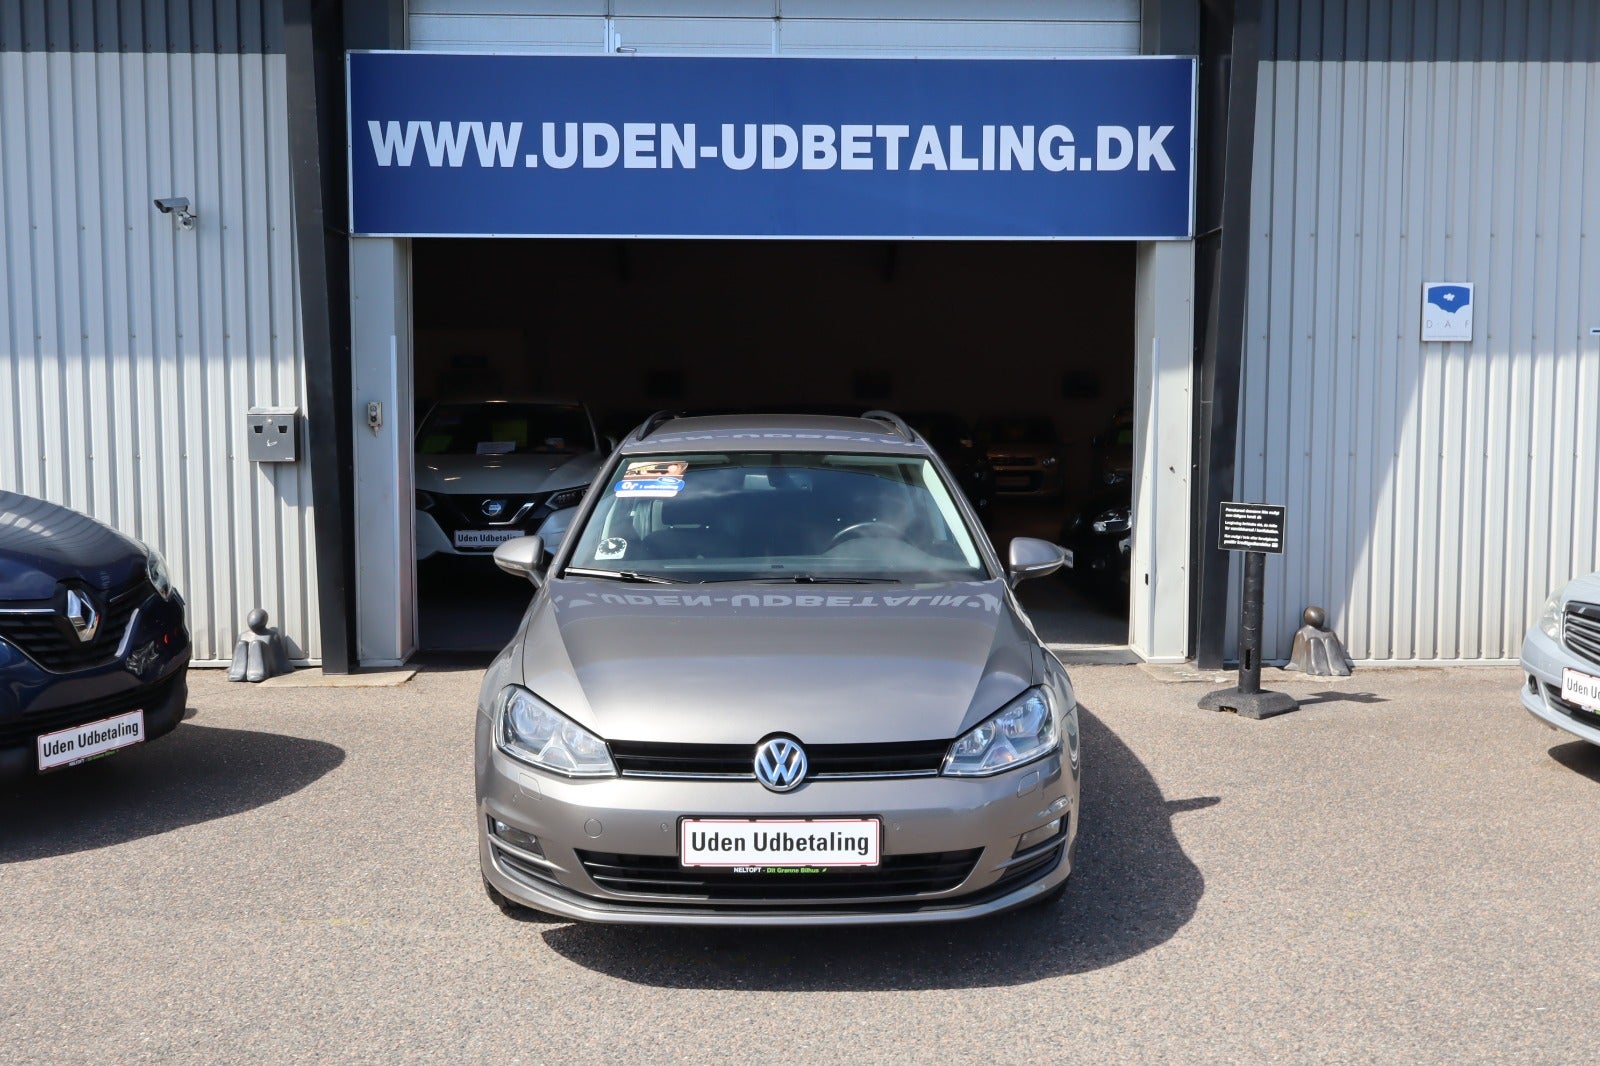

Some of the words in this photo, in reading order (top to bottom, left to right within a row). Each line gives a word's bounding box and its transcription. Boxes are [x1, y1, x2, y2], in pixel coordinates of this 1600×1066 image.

[367, 120, 1176, 172] WWW.UDEN-UDBETALING.DK
[458, 534, 478, 542] Uden
[480, 533, 516, 542] Udbetali
[1566, 677, 1588, 696] Uden
[43, 740, 74, 757] Uden
[78, 722, 139, 748] Udbetaling
[755, 739, 807, 791] VW
[692, 832, 746, 852] Uden
[753, 832, 869, 856] Udbetaling
